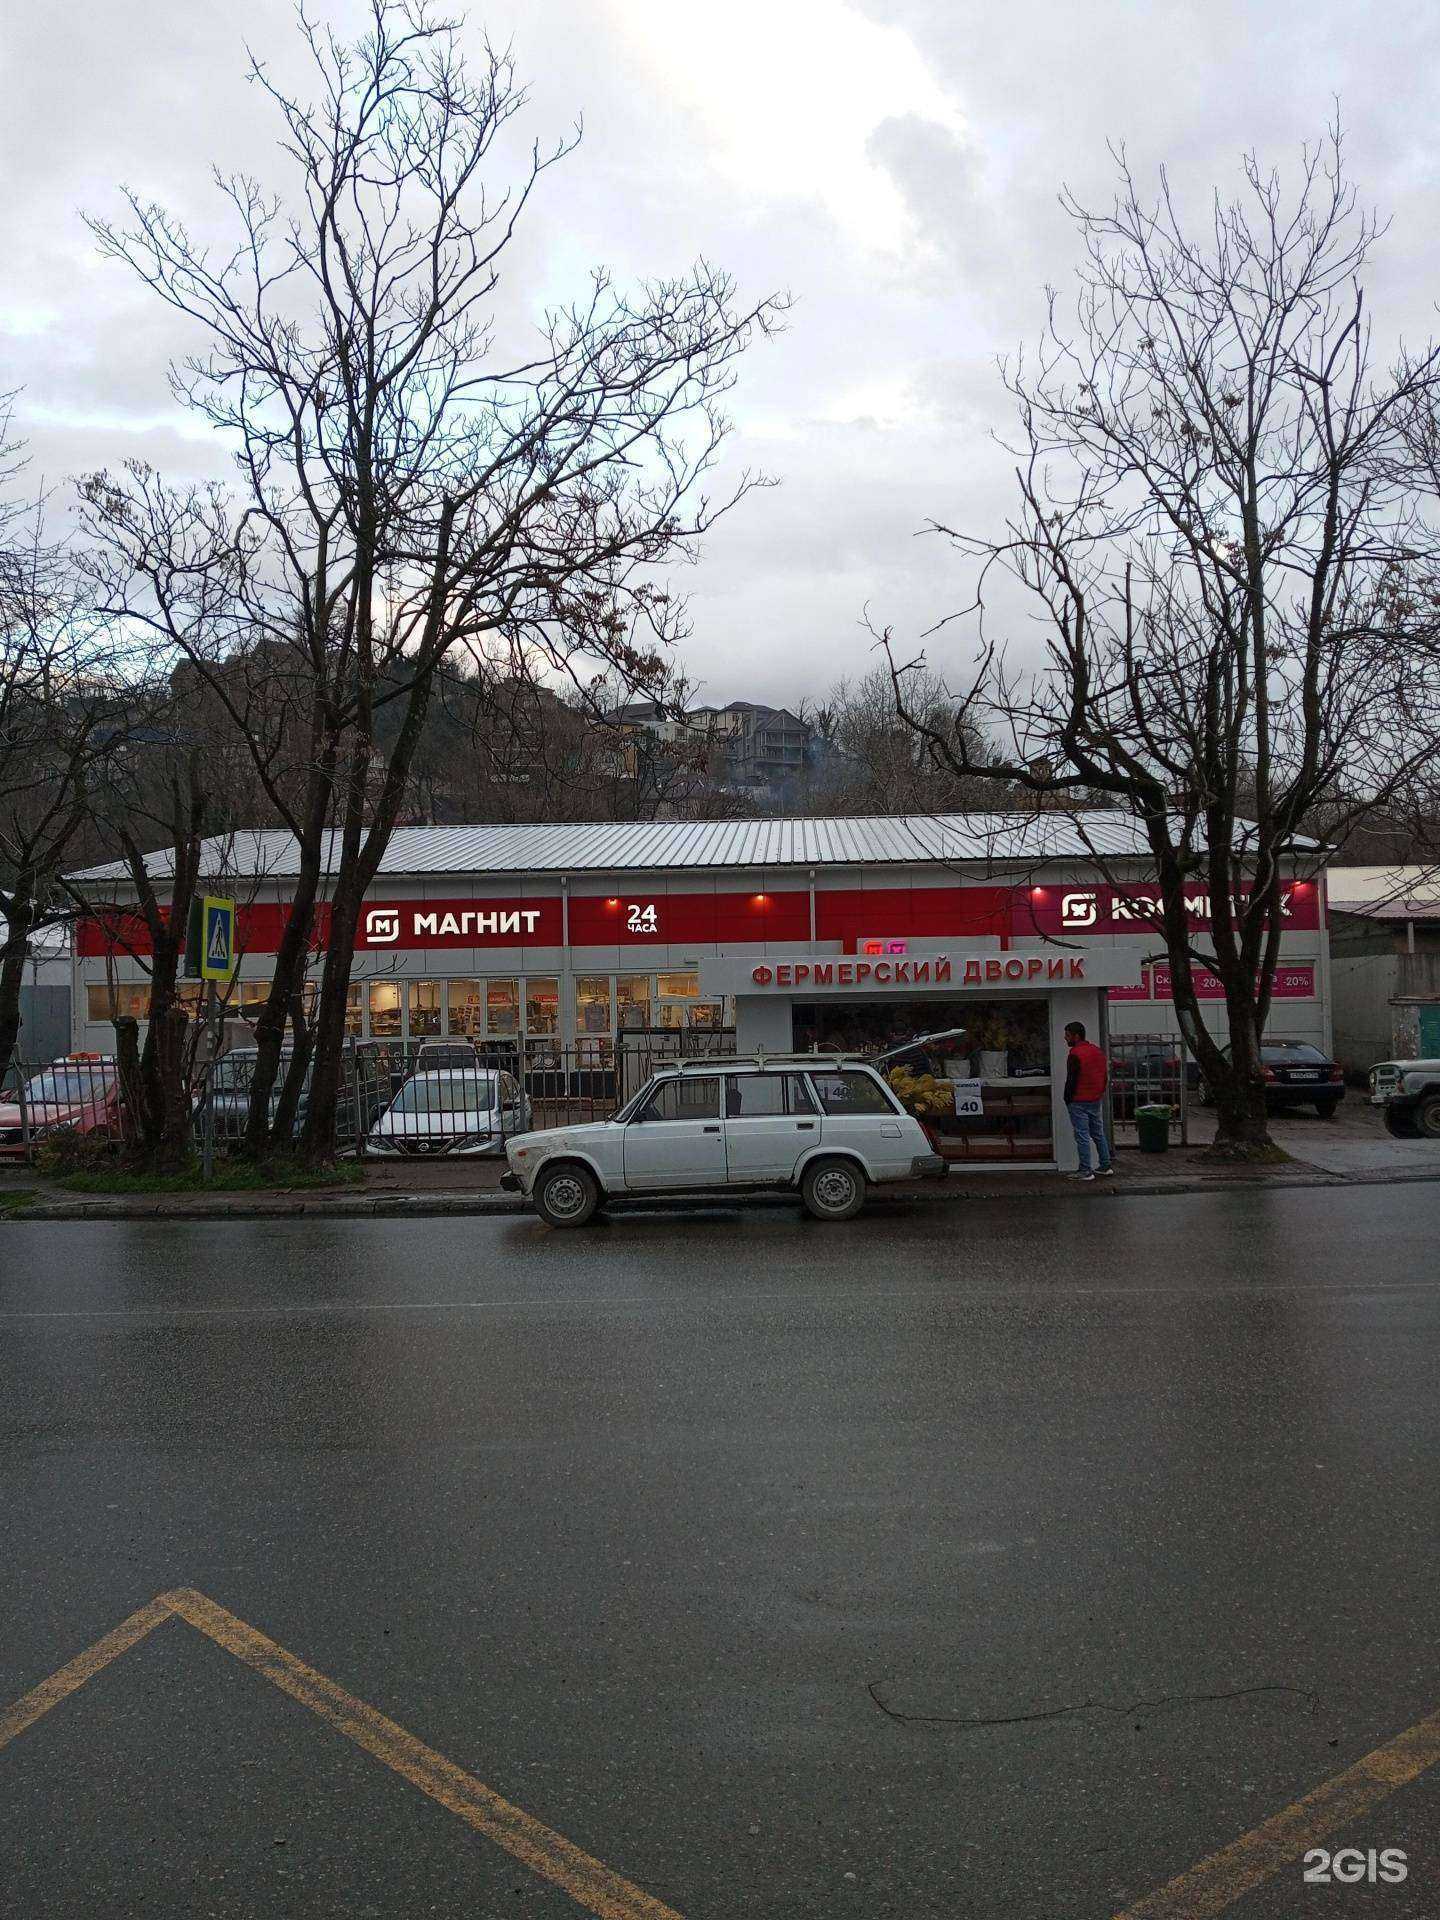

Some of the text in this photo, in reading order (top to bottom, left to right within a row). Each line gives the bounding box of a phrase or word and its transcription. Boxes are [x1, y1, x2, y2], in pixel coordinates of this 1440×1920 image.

[413, 911, 541, 935] МАГНИТ
[627, 904, 657, 923] 24
[627, 923, 657, 933] ЧАСА
[751, 955, 1086, 986] ФЕРМЕРСКИЙ ДВОРИК
[960, 1101, 979, 1112] 40
